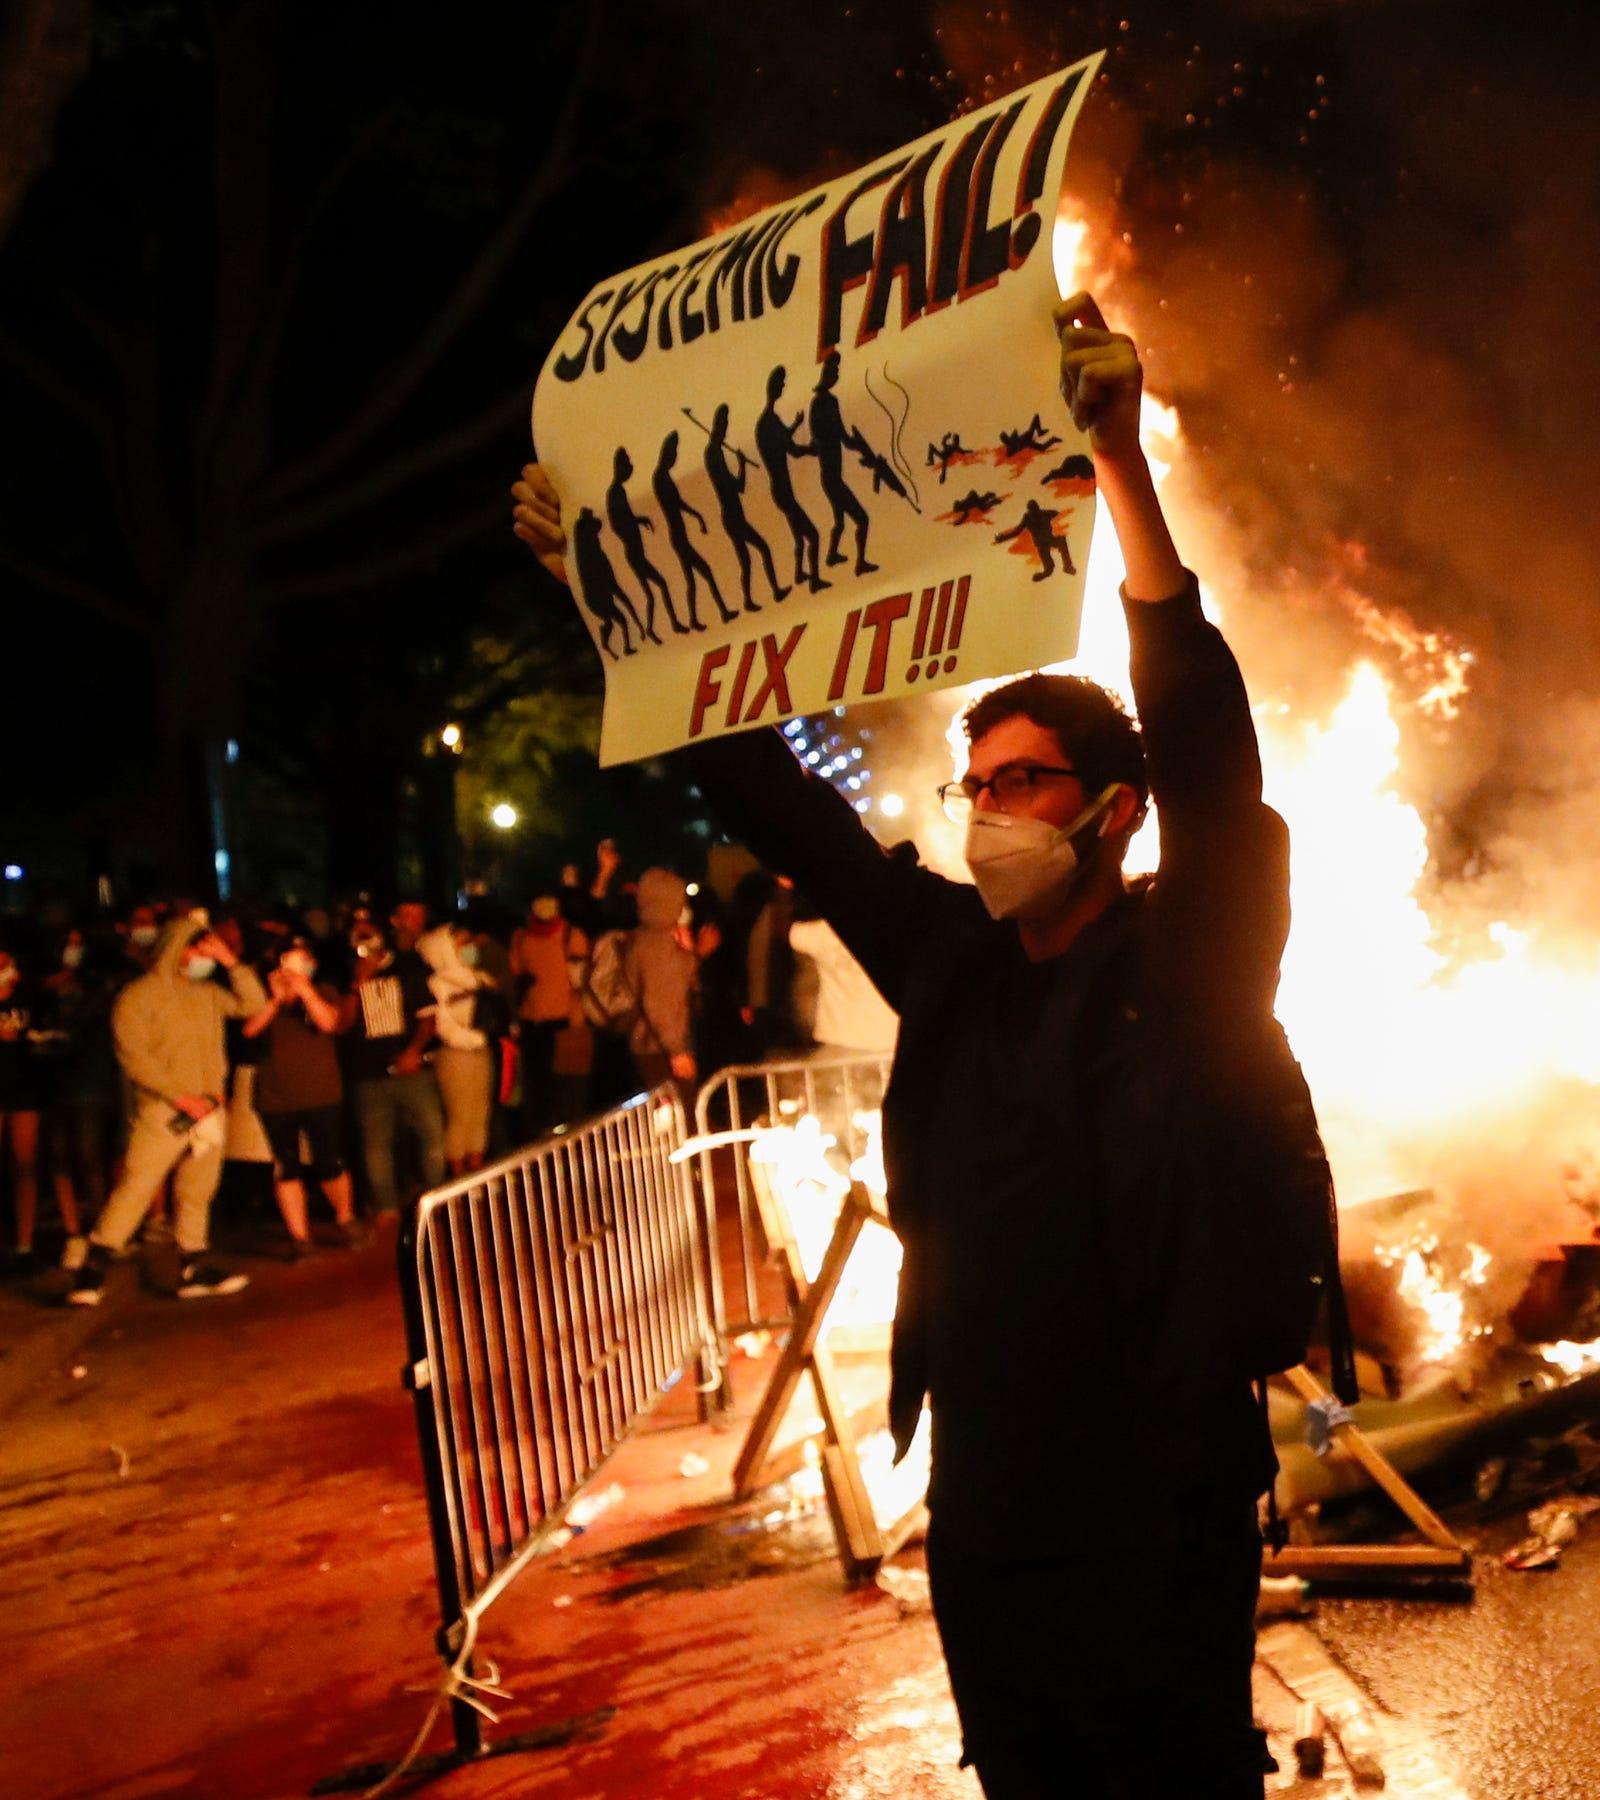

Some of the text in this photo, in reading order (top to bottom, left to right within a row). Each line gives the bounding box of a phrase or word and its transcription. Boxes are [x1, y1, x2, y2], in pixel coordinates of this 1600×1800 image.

[552, 64, 1089, 382] SYSTEMIC FAIL!
[688, 574, 972, 739] FIX IT!!!
